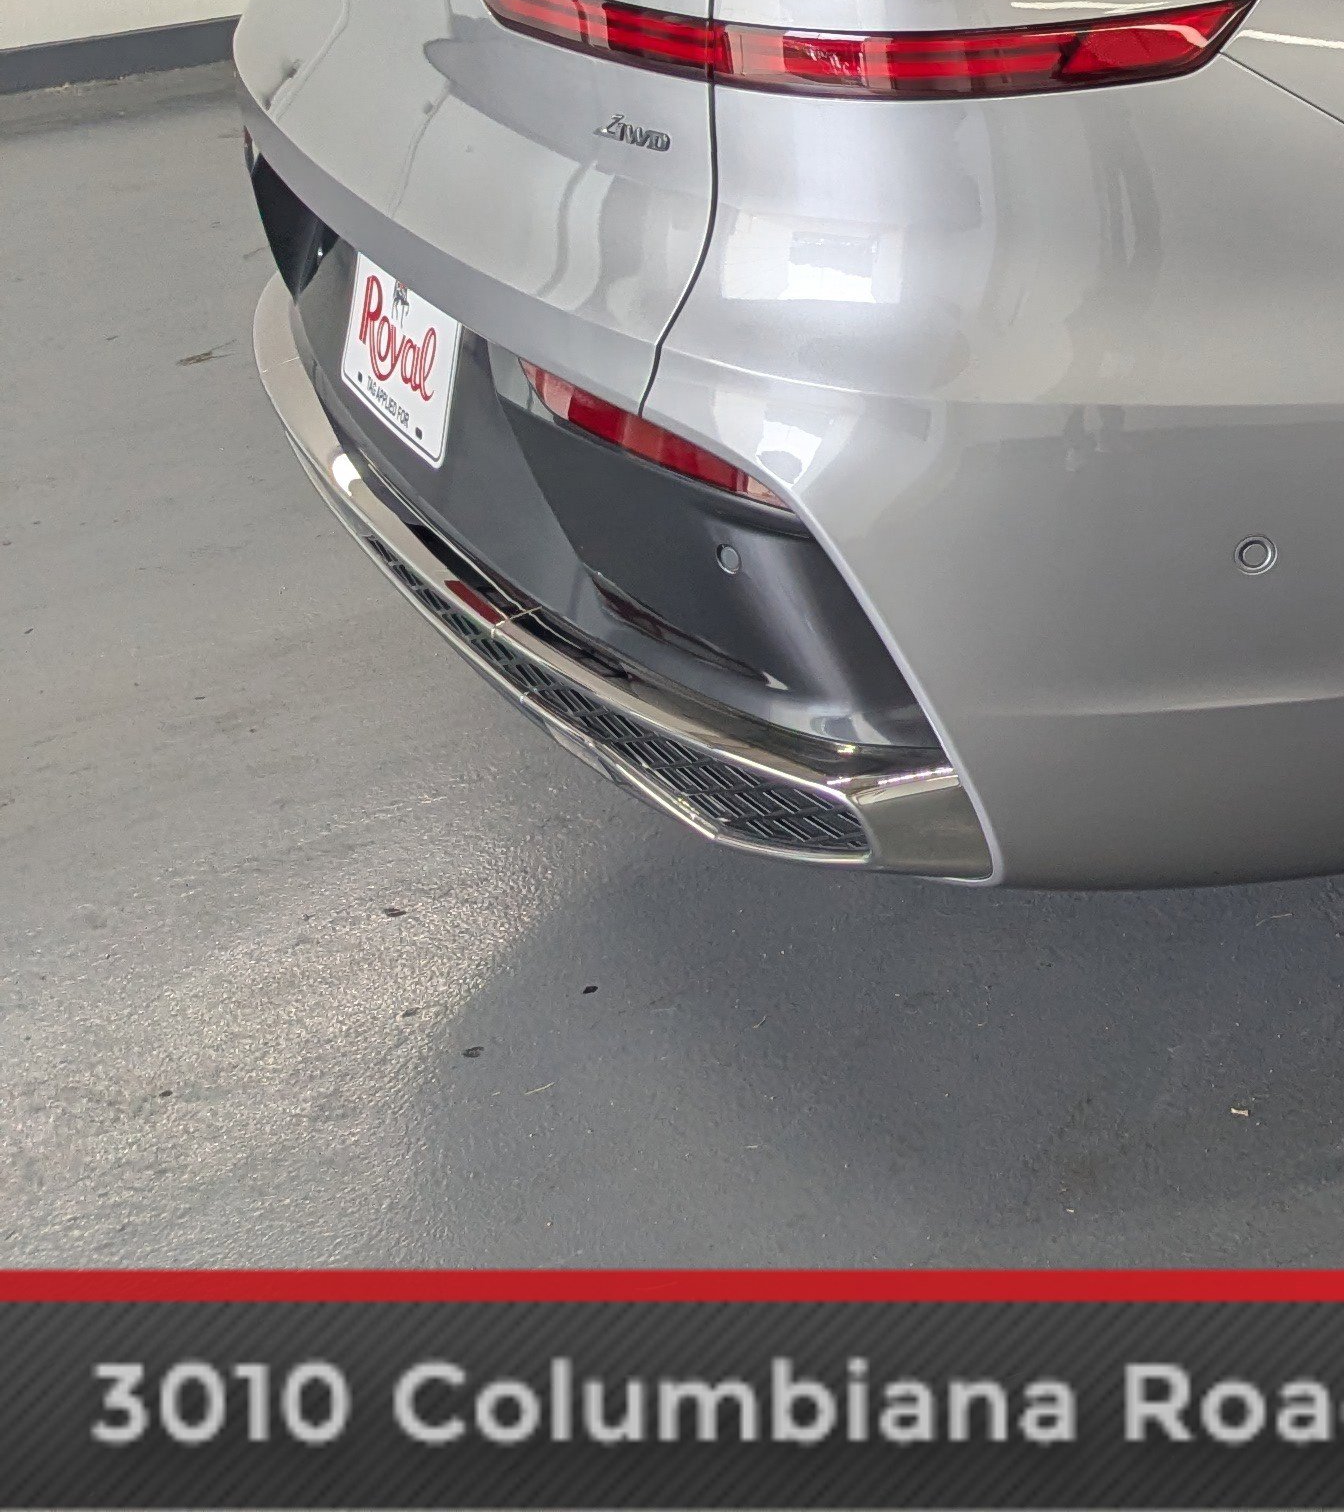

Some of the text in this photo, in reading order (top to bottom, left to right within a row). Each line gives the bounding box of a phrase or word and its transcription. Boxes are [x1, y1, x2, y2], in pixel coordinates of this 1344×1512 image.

[593, 113, 671, 152] AWD
[358, 274, 436, 402] Royal
[366, 375, 410, 429] TAG APPLIED FOR
